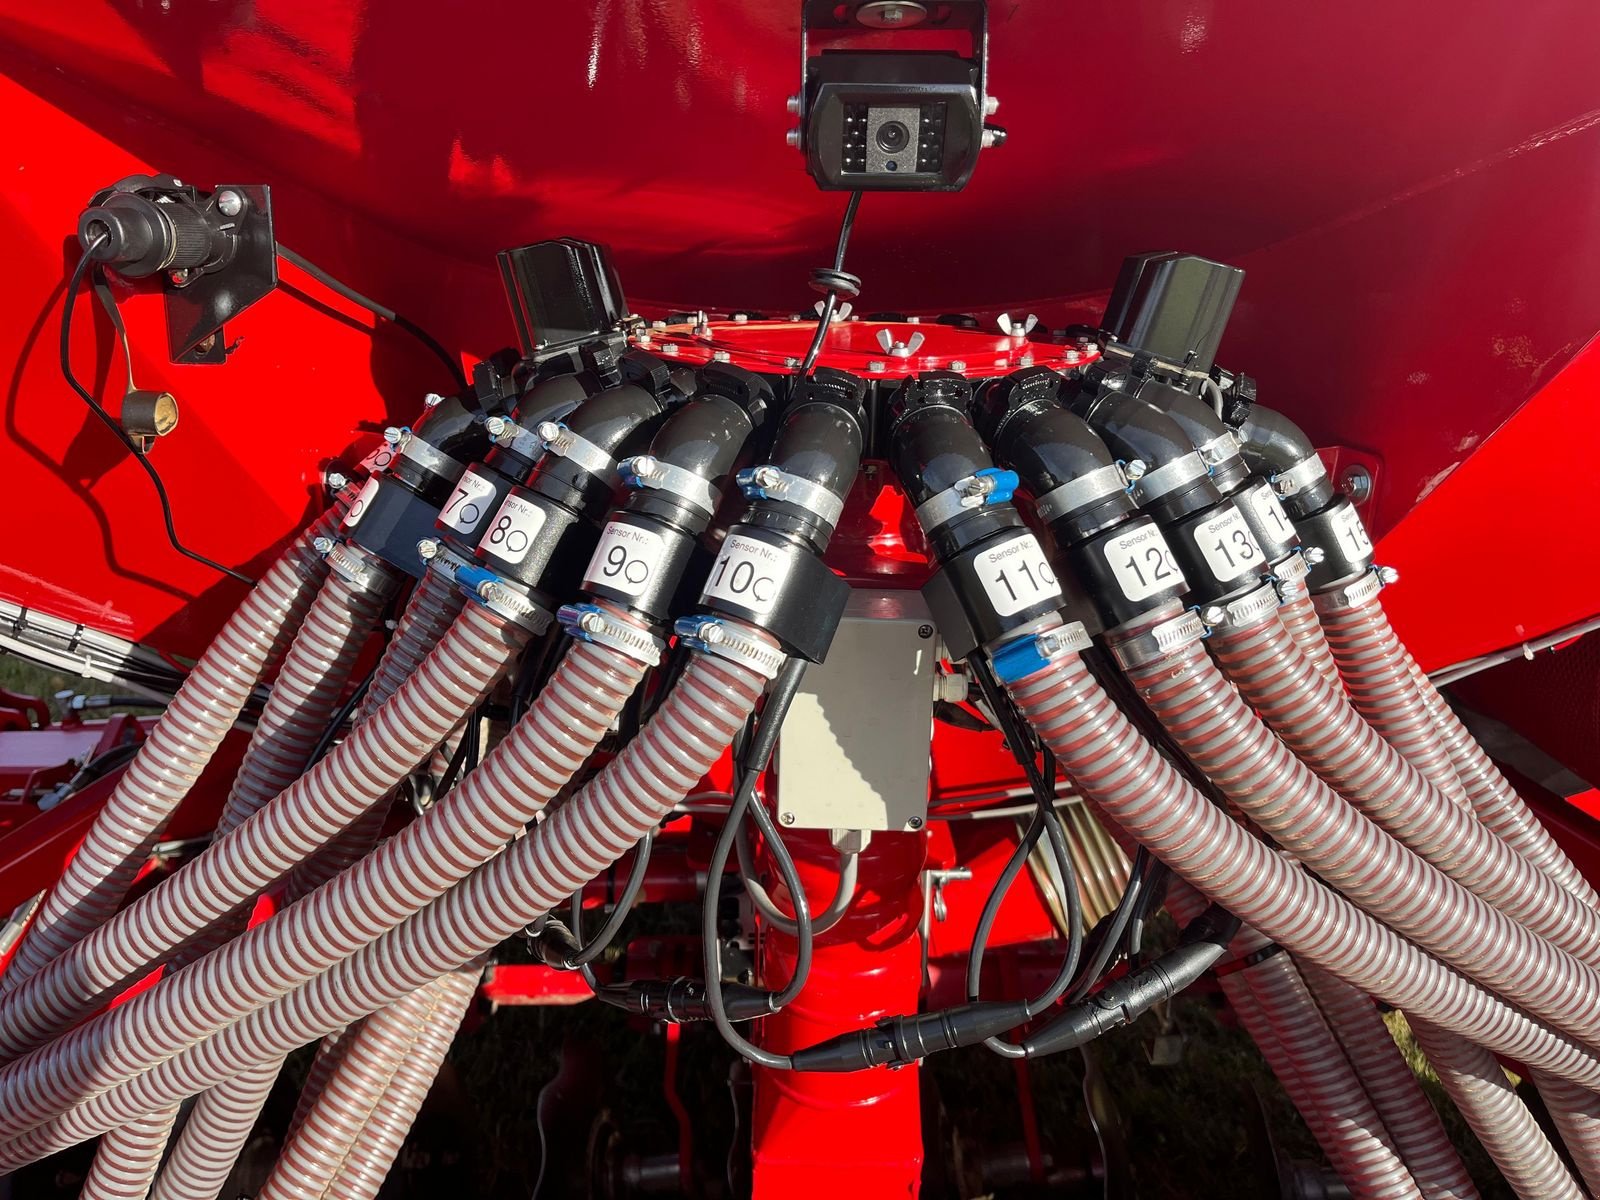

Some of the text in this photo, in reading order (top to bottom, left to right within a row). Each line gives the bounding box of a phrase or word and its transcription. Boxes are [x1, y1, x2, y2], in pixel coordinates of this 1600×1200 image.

[446, 487, 469, 514] 7
[490, 515, 512, 544] 8
[607, 525, 631, 538] Sensor
[1208, 516, 1234, 534] Sensor
[730, 540, 778, 562] Sensor Nr.:
[988, 544, 1020, 563] Sensor
[1119, 532, 1148, 550] Sensor
[1215, 530, 1254, 568] 13
[603, 545, 627, 577] 9
[714, 555, 755, 594] 10
[1125, 547, 1171, 587] 12
[995, 559, 1040, 601] 11
